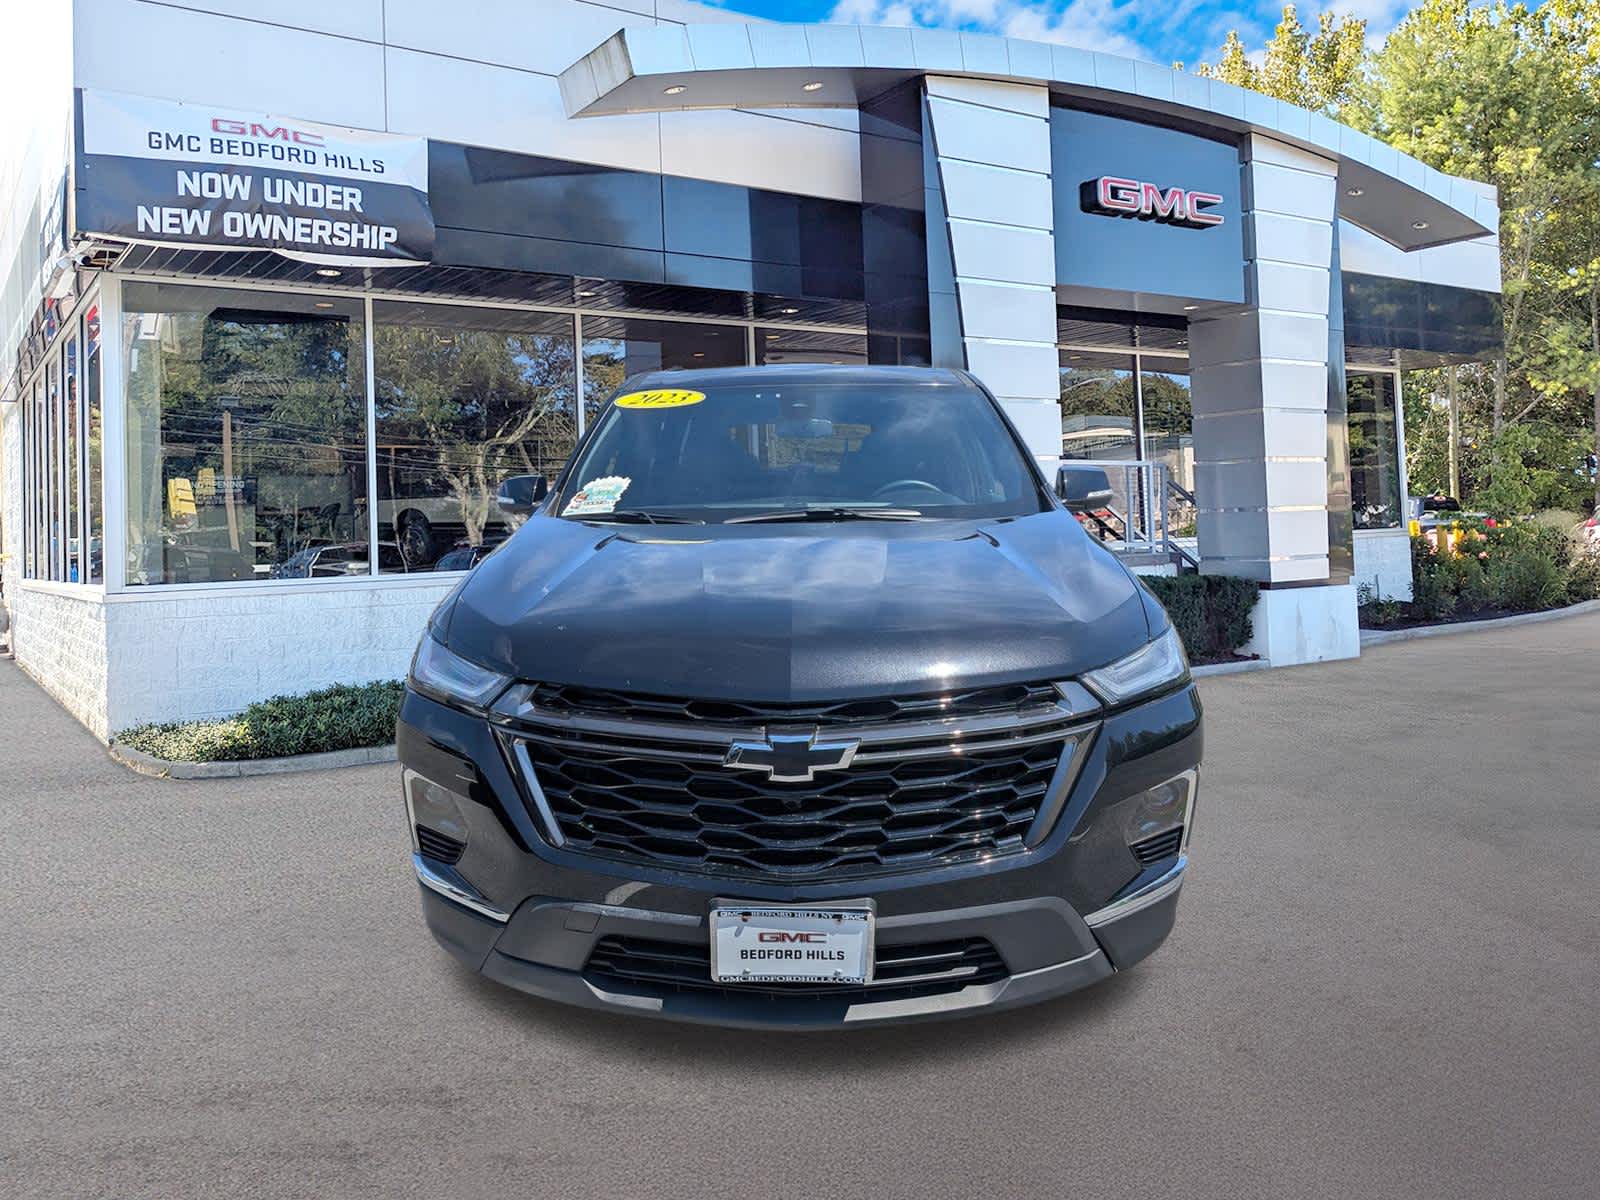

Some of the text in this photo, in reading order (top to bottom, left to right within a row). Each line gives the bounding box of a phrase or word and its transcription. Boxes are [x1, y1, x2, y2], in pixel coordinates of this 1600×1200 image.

[211, 117, 326, 148] GMC
[148, 131, 385, 174] GMC BEDFORD HILLS
[177, 170, 364, 213] NOW UNDER
[1097, 175, 1225, 225] GMC
[136, 205, 398, 251] NEW OWNERSHIP
[740, 949, 845, 961] BEDFORD HILLS
[758, 932, 828, 944] GMC
[720, 975, 864, 984] GMCBEDFORDHILLS.COM
